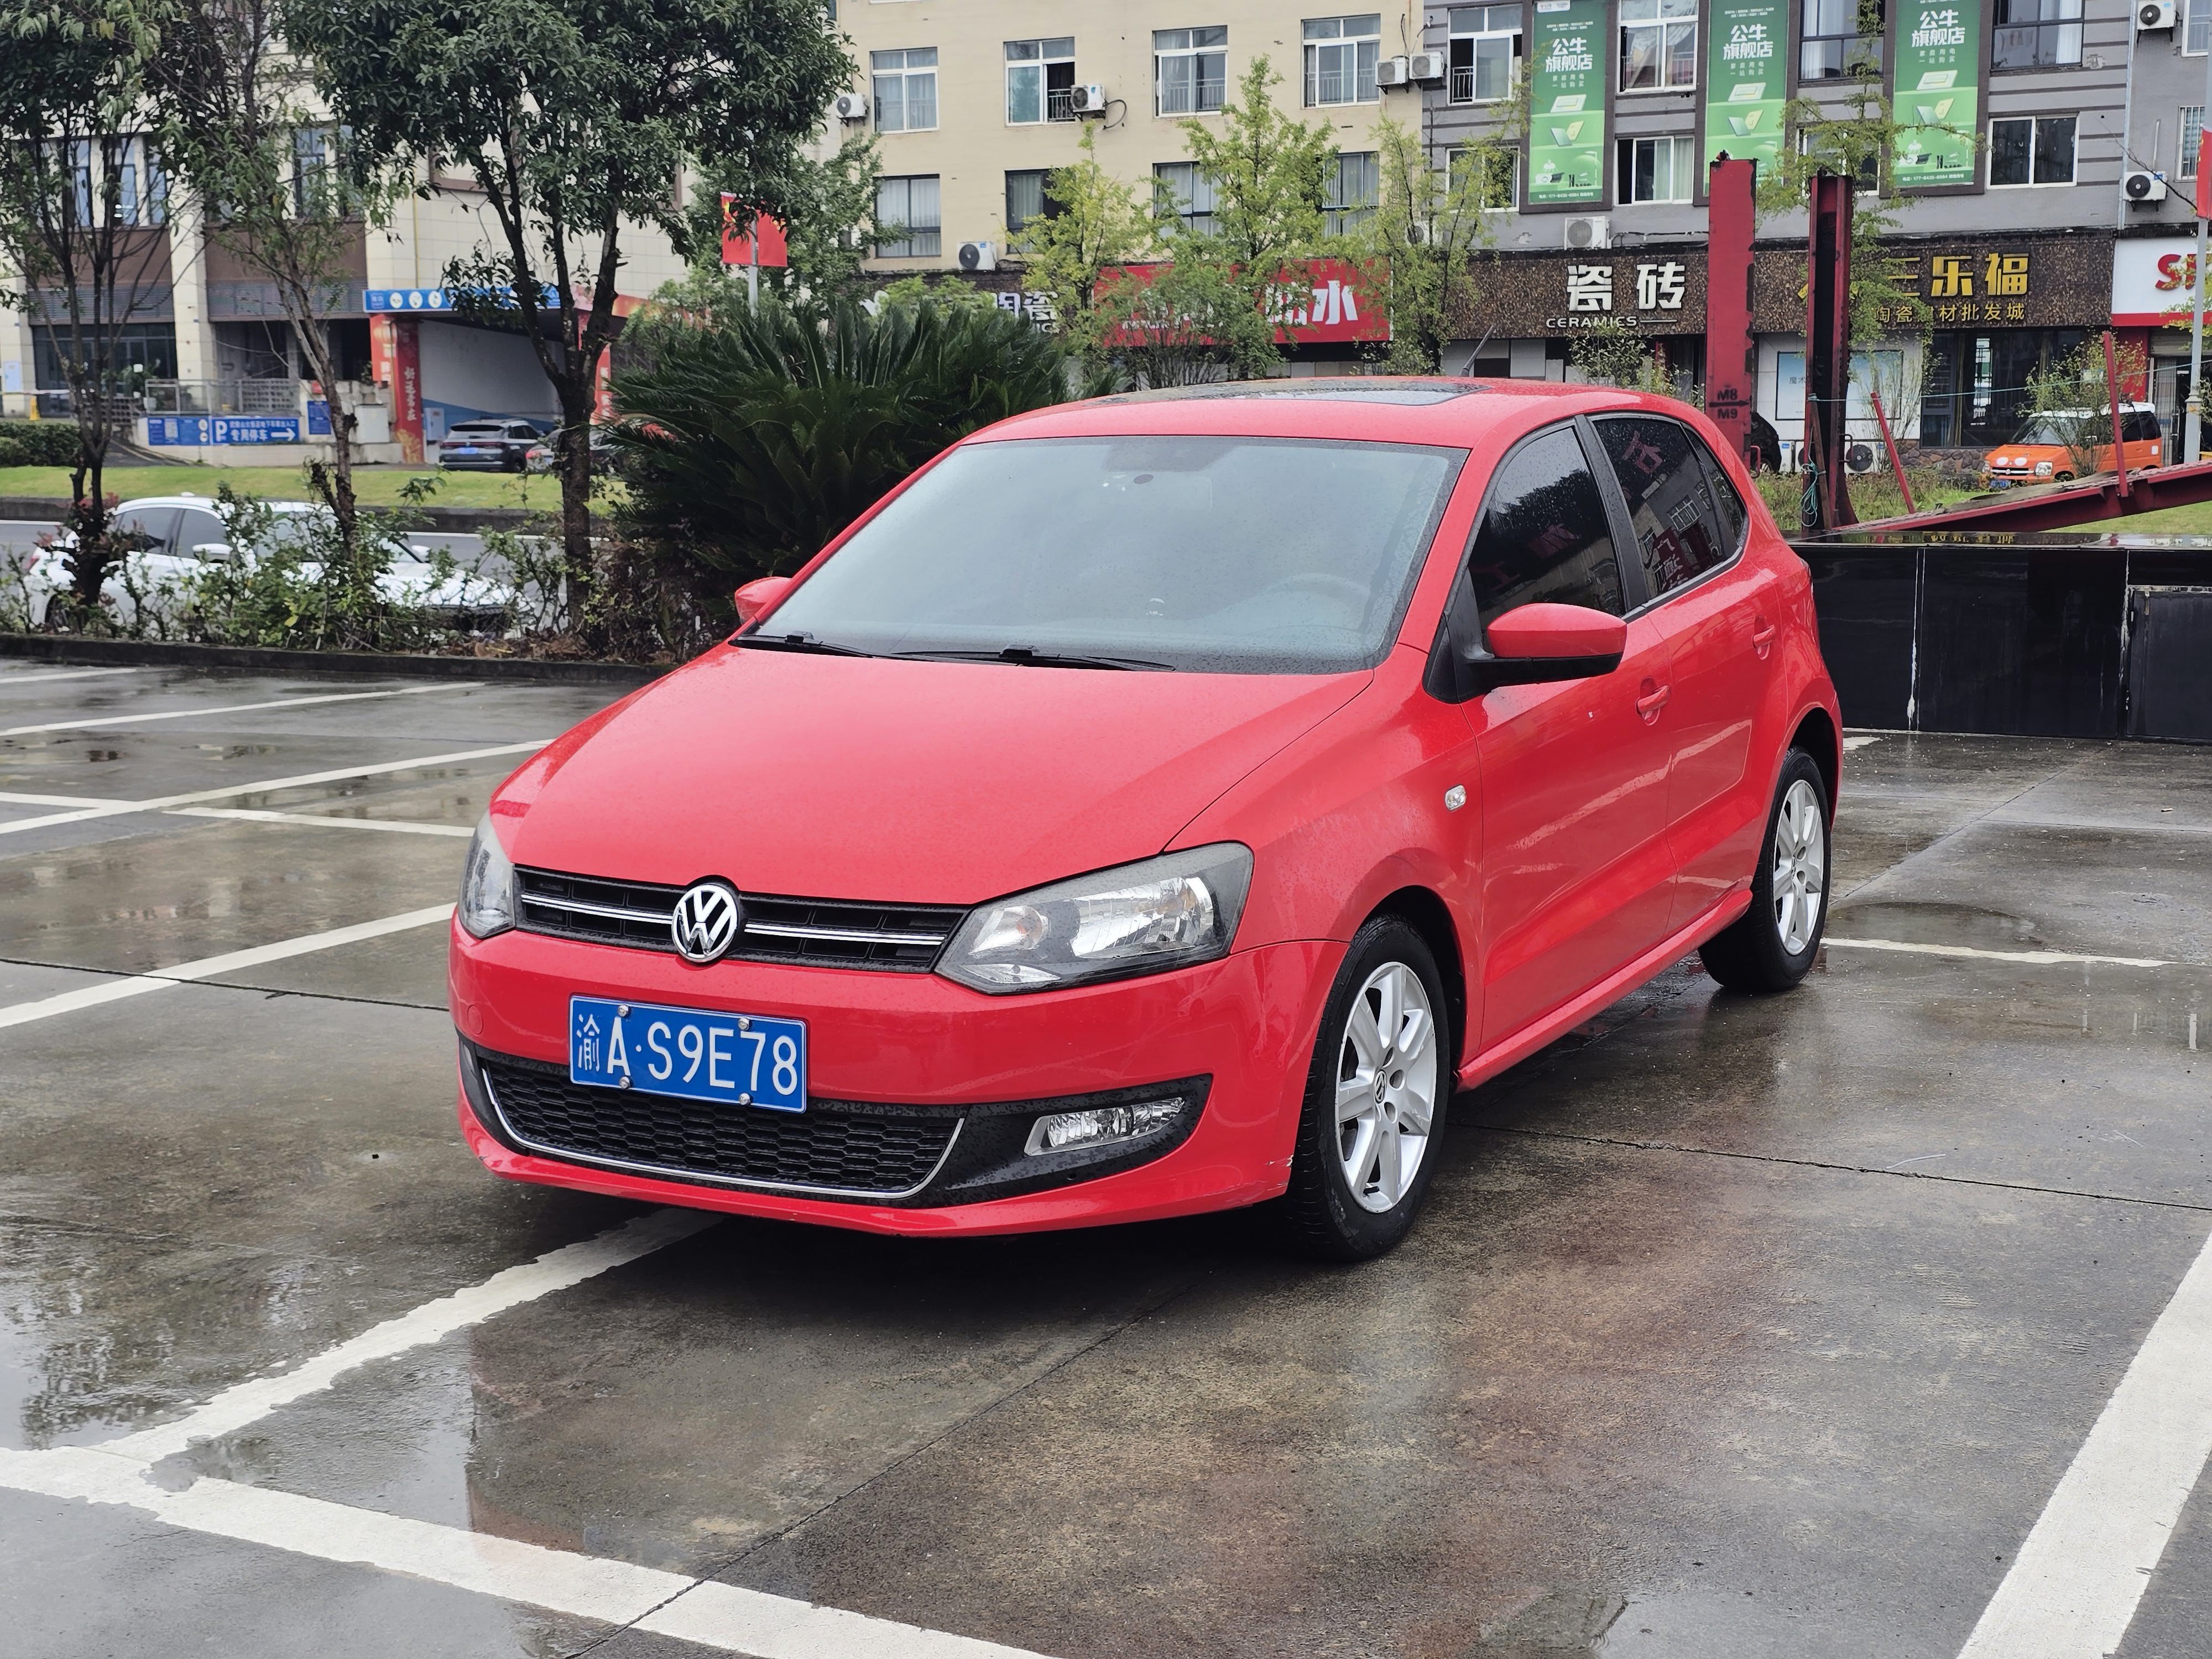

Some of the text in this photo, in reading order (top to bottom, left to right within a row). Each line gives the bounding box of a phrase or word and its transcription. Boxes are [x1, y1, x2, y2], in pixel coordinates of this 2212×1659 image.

[1919, 9, 1959, 29] 公牛
[1730, 24, 1767, 43] 公牛
[1911, 27, 1965, 48] 旗舰店
[1552, 37, 1587, 55] 公牛
[1723, 40, 1773, 60] 旗舰店
[1545, 54, 1593, 73] 旗舰店
[1567, 262, 1686, 311] 瓷砖
[1875, 302, 2025, 323] 陶瓷材批发城
[1717, 388, 1738, 401] M8
[1717, 408, 1738, 420] M9
